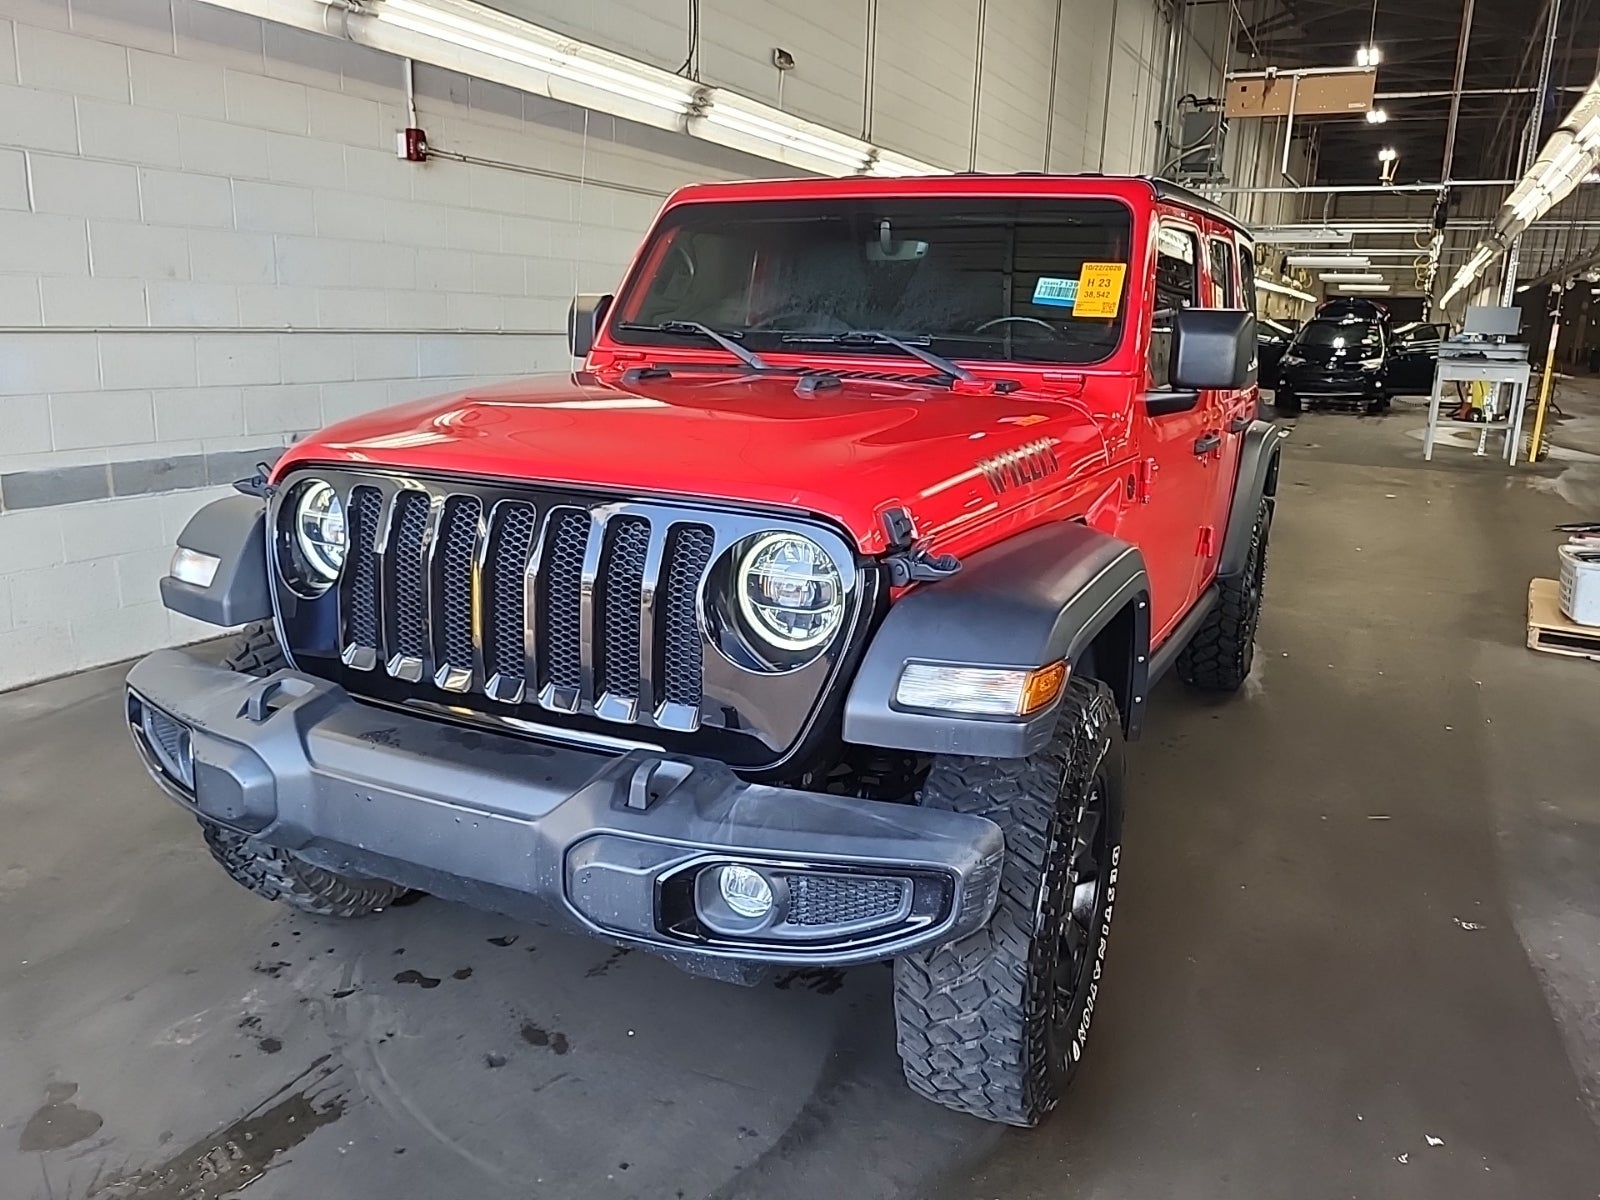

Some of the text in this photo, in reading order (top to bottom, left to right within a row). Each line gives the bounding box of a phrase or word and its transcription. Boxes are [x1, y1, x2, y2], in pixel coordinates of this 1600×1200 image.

[1087, 278, 1111, 287] H 23
[1084, 291, 1111, 299] 38,542
[1077, 845, 1121, 1047] DESTINATION
